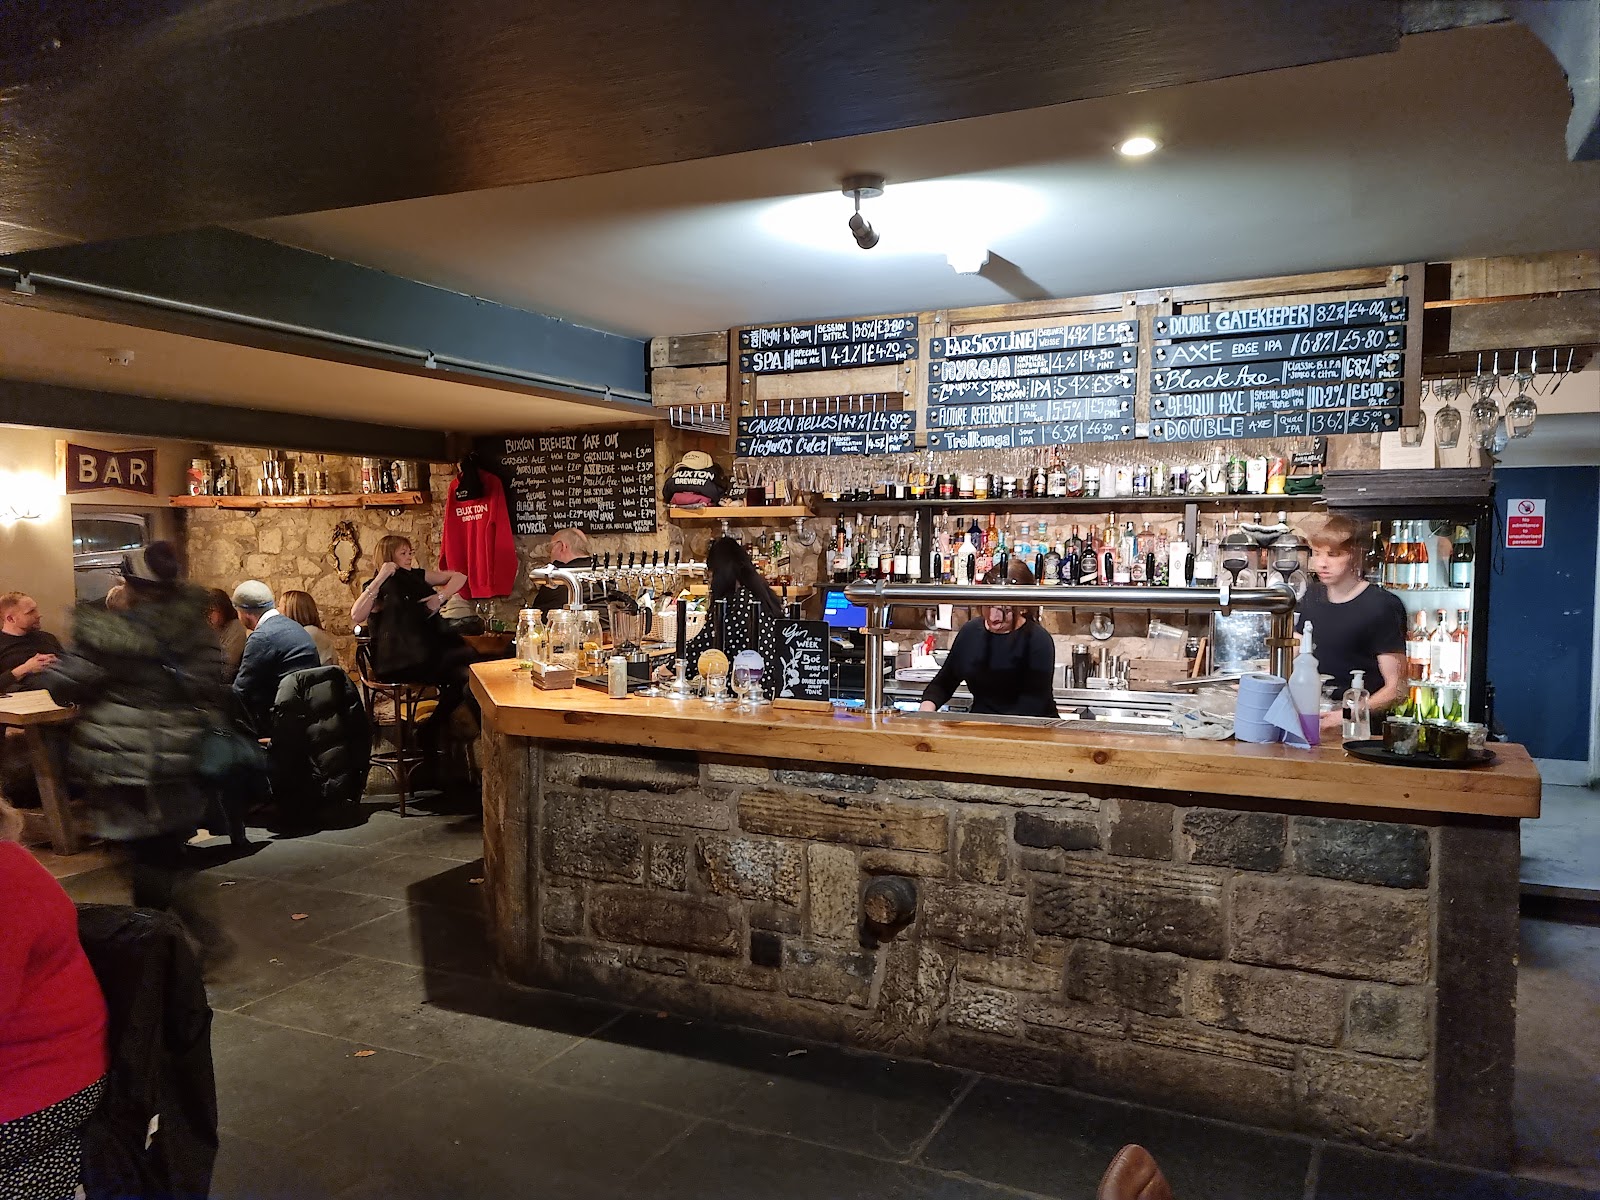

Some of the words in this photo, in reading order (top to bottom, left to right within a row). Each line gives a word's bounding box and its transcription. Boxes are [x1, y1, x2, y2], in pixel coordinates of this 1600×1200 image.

[1316, 304, 1346, 322] 8.2%
[1349, 301, 1384, 319] £4.00
[818, 322, 846, 334] SESSION
[877, 319, 904, 335] £3.80
[1170, 315, 1211, 336] DOUBLE
[1216, 305, 1309, 331] GATEKEEPER
[762, 328, 781, 347] Right
[783, 327, 790, 342] to
[790, 326, 812, 345] Roam
[823, 331, 849, 341] BITTER
[1300, 331, 1335, 355] 6.8%
[1338, 330, 1384, 352] £5.80
[753, 351, 784, 371] SPA
[794, 347, 820, 358] SPECIAL
[794, 358, 808, 366] PALE
[809, 356, 820, 364] ALE
[830, 344, 861, 364] 4.1%
[867, 342, 901, 362] £4.20
[1083, 349, 1114, 363] £4.50
[1170, 342, 1223, 365] AXE
[1231, 341, 1259, 355] EDGE
[1264, 340, 1283, 352] IPA
[1052, 352, 1077, 373] 4%
[1097, 361, 1114, 370] PINT
[1160, 367, 1235, 392] Black
[991, 385, 1026, 402] DRAGON
[1031, 380, 1052, 399] IPA
[1254, 390, 1280, 401] SPECIAL
[1052, 401, 1083, 421] 5.5%
[1165, 393, 1214, 417] SESQUI
[1219, 391, 1247, 415] AXE
[1292, 398, 1304, 406] IPA
[872, 412, 903, 430] £4.80
[939, 407, 968, 426] FUTURE
[971, 404, 1014, 425] REFERENCE
[1104, 409, 1121, 419] PINT
[1280, 413, 1304, 424] Quad
[1052, 424, 1078, 443] 6.3%
[1086, 422, 1113, 435] £6.30
[1164, 417, 1244, 441] DOUBLE
[1248, 419, 1273, 432] AXE
[1284, 424, 1302, 434] IPA
[505, 437, 534, 454] BUXTON
[539, 436, 577, 451] BREWERY
[582, 434, 600, 450] TAKE
[604, 432, 619, 449] OUT
[796, 436, 828, 454] Cider
[944, 431, 1010, 449] Trölltunga
[1021, 436, 1034, 445] IPA
[79, 453, 148, 486] BAR
[675, 478, 707, 486] BREWERY
[456, 504, 488, 516] BUXTON
[782, 623, 808, 645] Gin
[796, 640, 819, 649] WEEK
